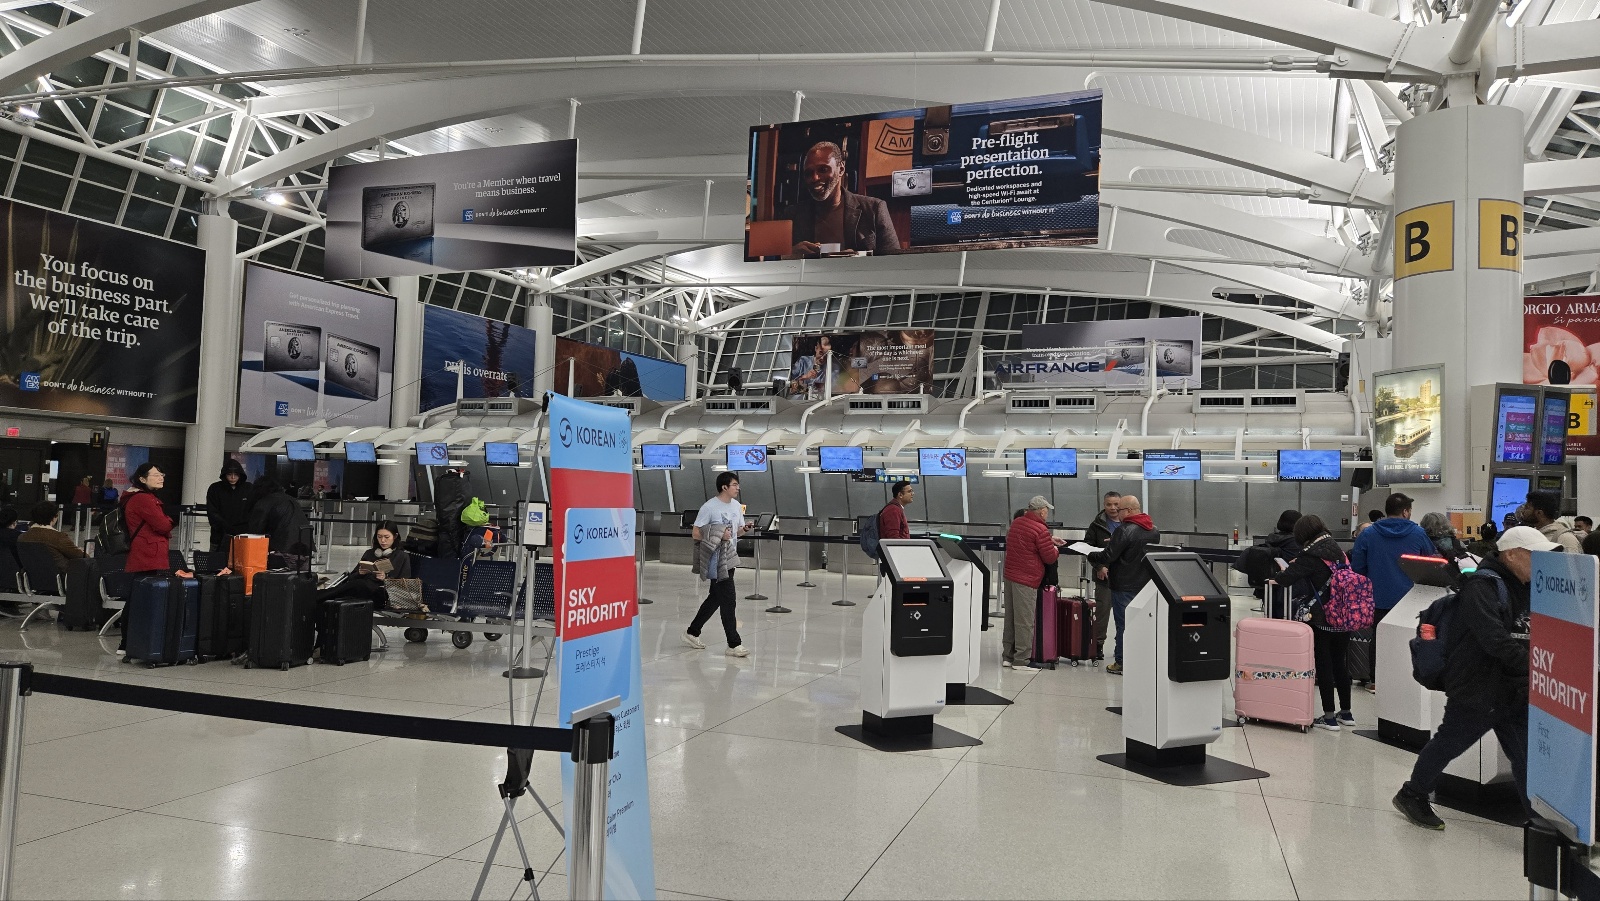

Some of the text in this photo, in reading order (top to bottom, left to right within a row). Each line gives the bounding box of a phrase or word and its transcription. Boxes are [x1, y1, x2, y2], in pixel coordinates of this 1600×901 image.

[888, 137, 912, 149] AM
[972, 132, 1039, 149] Pre-flight
[960, 147, 1049, 168] presentation
[453, 181, 475, 190] You're
[483, 177, 514, 187] Member
[515, 176, 537, 185] when
[538, 173, 561, 183] travel
[966, 164, 1042, 183] perfection.
[475, 187, 536, 198] means business.
[996, 182, 1030, 190] workspaces
[496, 209, 519, 217] business
[991, 209, 1021, 218] business
[1405, 220, 1430, 264] B
[1500, 214, 1519, 257] B
[40, 253, 155, 292] You focus on
[14, 270, 173, 314] the business part.
[29, 293, 160, 330] We'll take care
[289, 291, 299, 300] Get
[300, 295, 330, 306] personalized
[341, 304, 360, 314] planning
[301, 303, 325, 312] American
[325, 307, 345, 317] Express
[48, 319, 141, 348] of the trip.
[463, 364, 472, 376] is
[43, 381, 66, 389] DON'T
[67, 379, 77, 391] do
[79, 381, 116, 395] business
[116, 389, 146, 398] WITHOUT
[1569, 412, 1581, 428] B
[576, 425, 616, 448] KOREAN
[586, 527, 618, 539] KOREAN
[1545, 577, 1576, 596] KOREAN
[569, 586, 597, 607] SKY
[567, 601, 628, 628] PRIORITY
[575, 645, 600, 660] Prestige
[1532, 645, 1555, 673] SKY
[1532, 669, 1587, 714] PRIORITY
